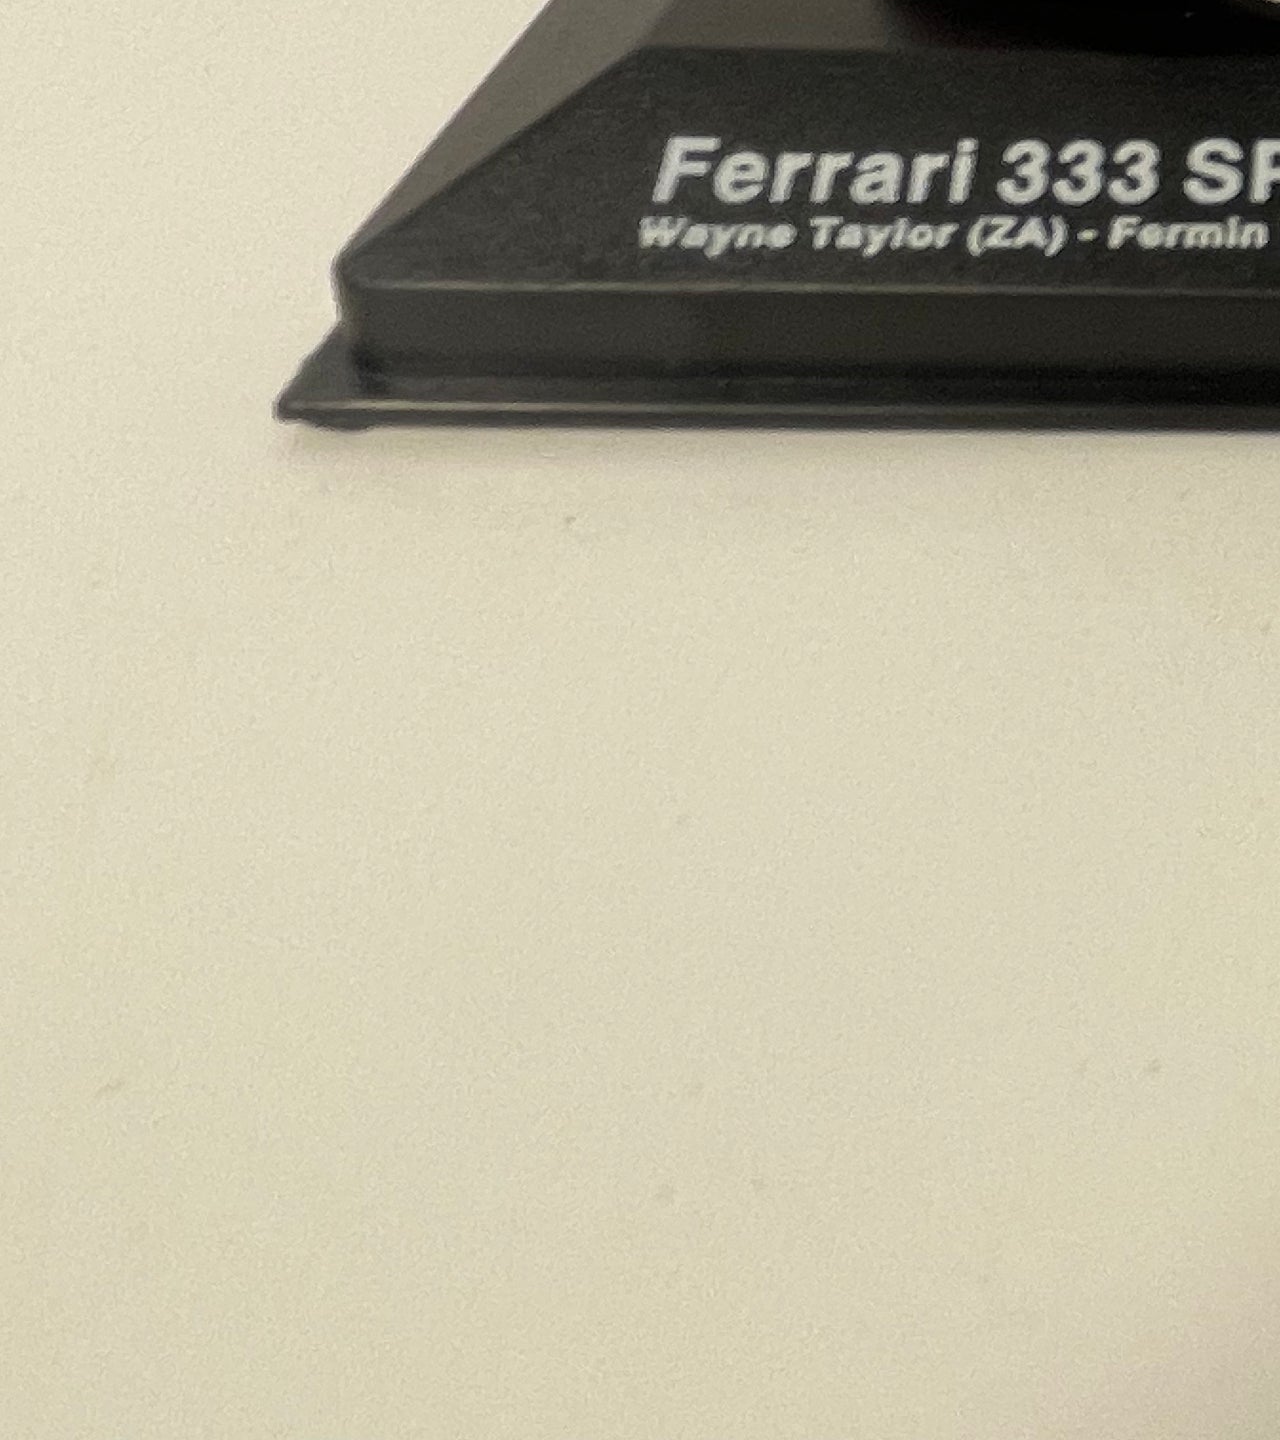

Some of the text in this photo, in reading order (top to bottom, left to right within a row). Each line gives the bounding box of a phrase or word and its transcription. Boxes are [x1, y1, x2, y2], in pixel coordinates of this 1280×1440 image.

[652, 135, 979, 205] Ferrari
[995, 137, 1161, 205] 333
[638, 215, 798, 259] Wayne
[809, 215, 962, 258] Taylor
[965, 215, 1068, 258] (ZA)
[1107, 215, 1269, 251] Fermin
